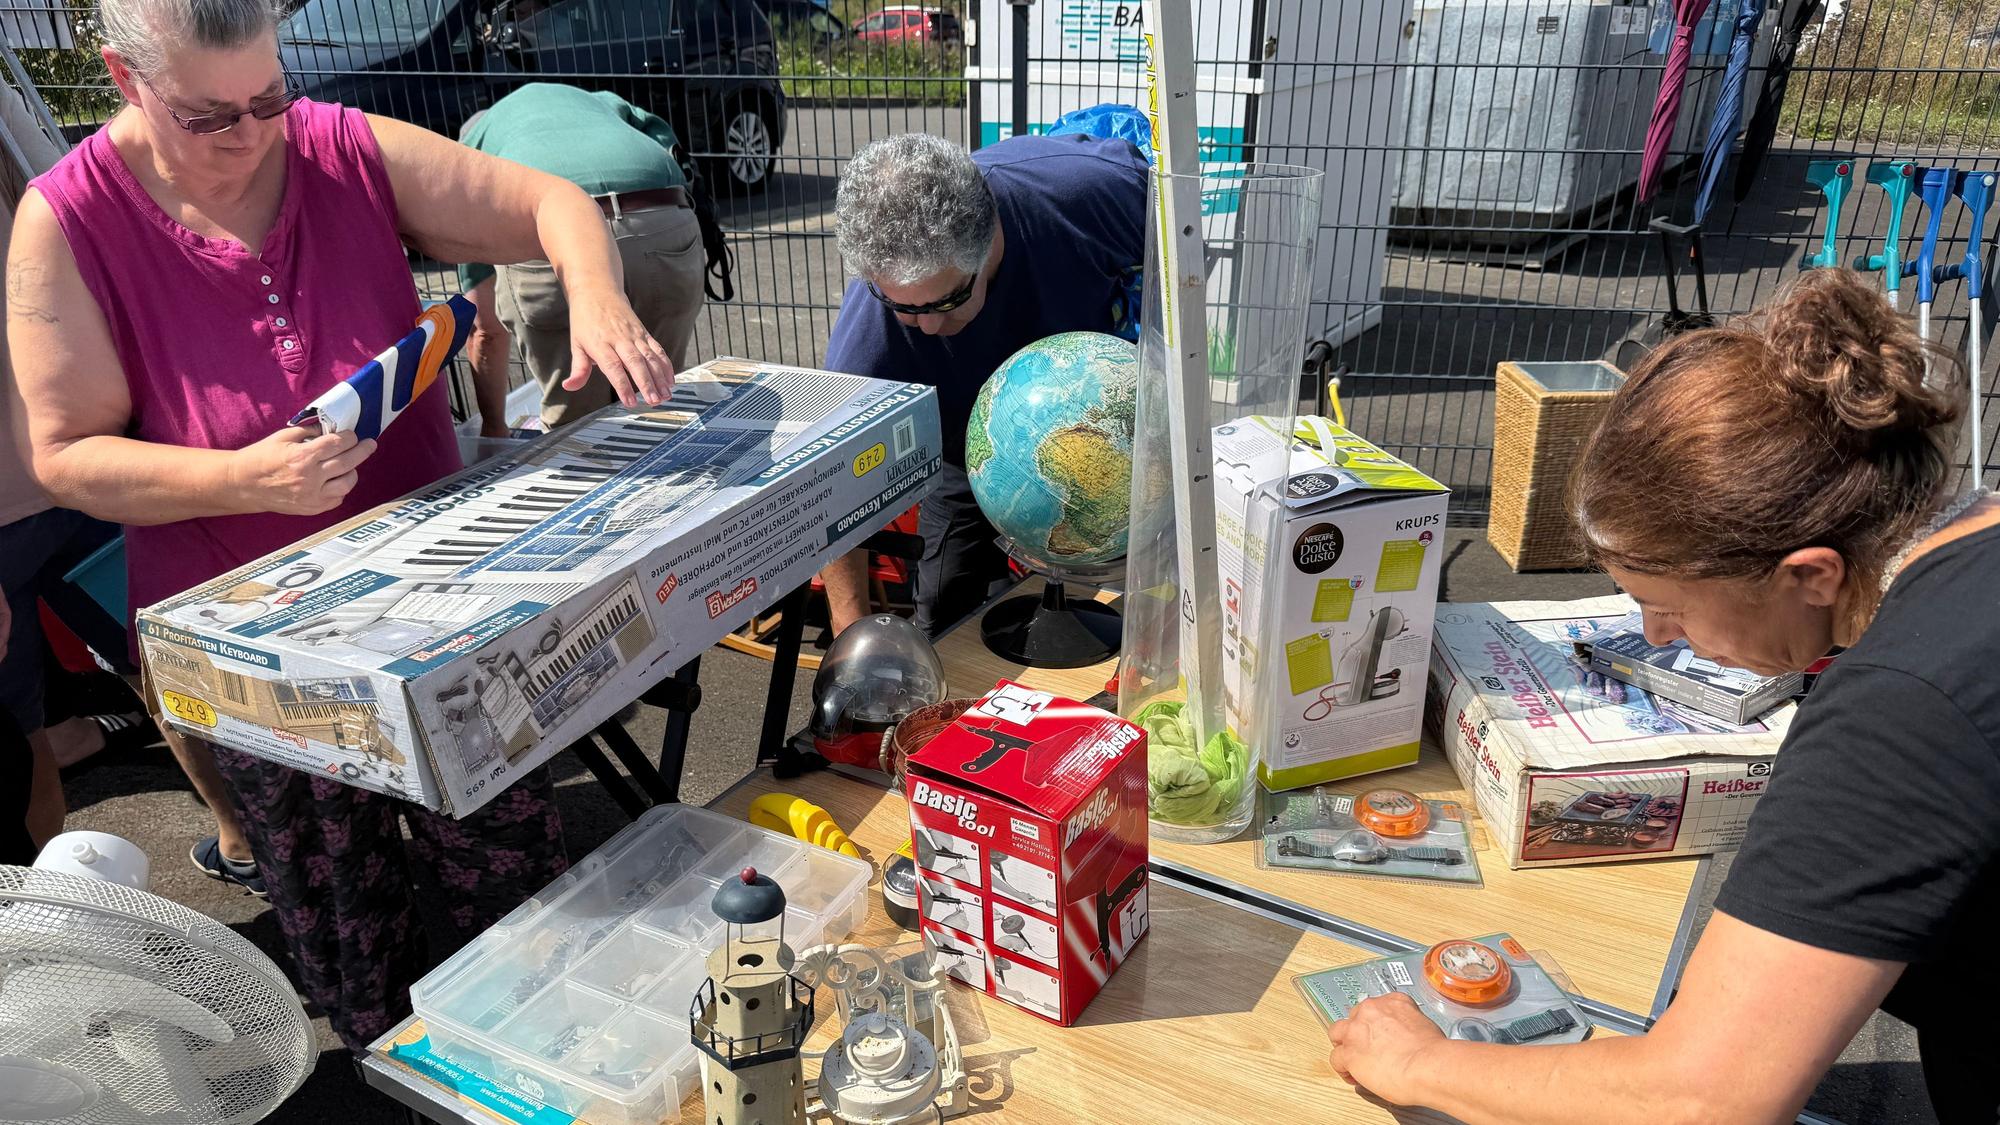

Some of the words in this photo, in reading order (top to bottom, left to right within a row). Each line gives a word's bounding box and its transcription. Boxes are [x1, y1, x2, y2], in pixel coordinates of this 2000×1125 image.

[1113, 6, 1144, 28] BA
[903, 383, 927, 394] 61
[829, 392, 908, 439] PROFITASTEN
[760, 439, 836, 479] KEYBOARD
[857, 447, 879, 473] 249
[886, 447, 926, 483] BONTEMPI
[930, 456, 940, 472] 61
[777, 459, 844, 507] VERBINDUNGSKABEL
[882, 465, 927, 503] PROFITASTEN
[407, 486, 495, 524] SOFORT
[766, 499, 776, 515] für
[800, 485, 832, 513] ADAPTER,
[739, 516, 748, 531] PC
[750, 506, 764, 524] den
[837, 495, 880, 533] KEYBOARD
[1395, 514, 1440, 531] KRUPS
[722, 522, 737, 539] und
[743, 506, 799, 550] NOTENSTÄNDER
[784, 512, 823, 544] NOTENHEFT
[1304, 531, 1335, 544] NESCAFÉ
[703, 532, 720, 551] Midi
[727, 540, 741, 557] und
[765, 543, 772, 554] 50
[774, 537, 782, 549] mit
[1301, 541, 1336, 555] Dolce
[651, 543, 701, 580] Instrumente
[677, 550, 725, 589] KOPFHÖRER
[733, 562, 742, 575] für
[743, 548, 765, 569] Liedern
[759, 541, 813, 583] MUSIKMETHODE
[1300, 551, 1335, 564] Gusto
[720, 569, 731, 583] den
[278, 592, 300, 604] NEU
[659, 575, 675, 602] NEU
[687, 576, 719, 603] Einsteiger
[290, 597, 349, 621] NOTENHEFT
[148, 624, 160, 637] 61
[163, 625, 217, 651] PROFITASTEN
[220, 642, 268, 665] KEYBOARD
[447, 615, 524, 653] MUSIKMETHODE
[1484, 641, 1520, 675] Stein
[1637, 668, 1679, 687] telefonregister
[172, 696, 208, 720] 249
[1508, 679, 1558, 729] Heißer
[1103, 723, 1140, 760] Basic
[1457, 711, 1481, 754] Heißer
[1481, 742, 1501, 782] Stein
[466, 780, 485, 797] 695
[1702, 779, 1763, 796] Heißer
[912, 781, 980, 821] Basic
[1094, 793, 1119, 830] tool
[957, 815, 996, 838] tool
[1019, 822, 1036, 831] Monate
[1064, 787, 1109, 852] Basic
[1012, 834, 1029, 844] Service
[1031, 841, 1050, 852] Hotline
[480, 1087, 535, 1118] www.bavweb.de
